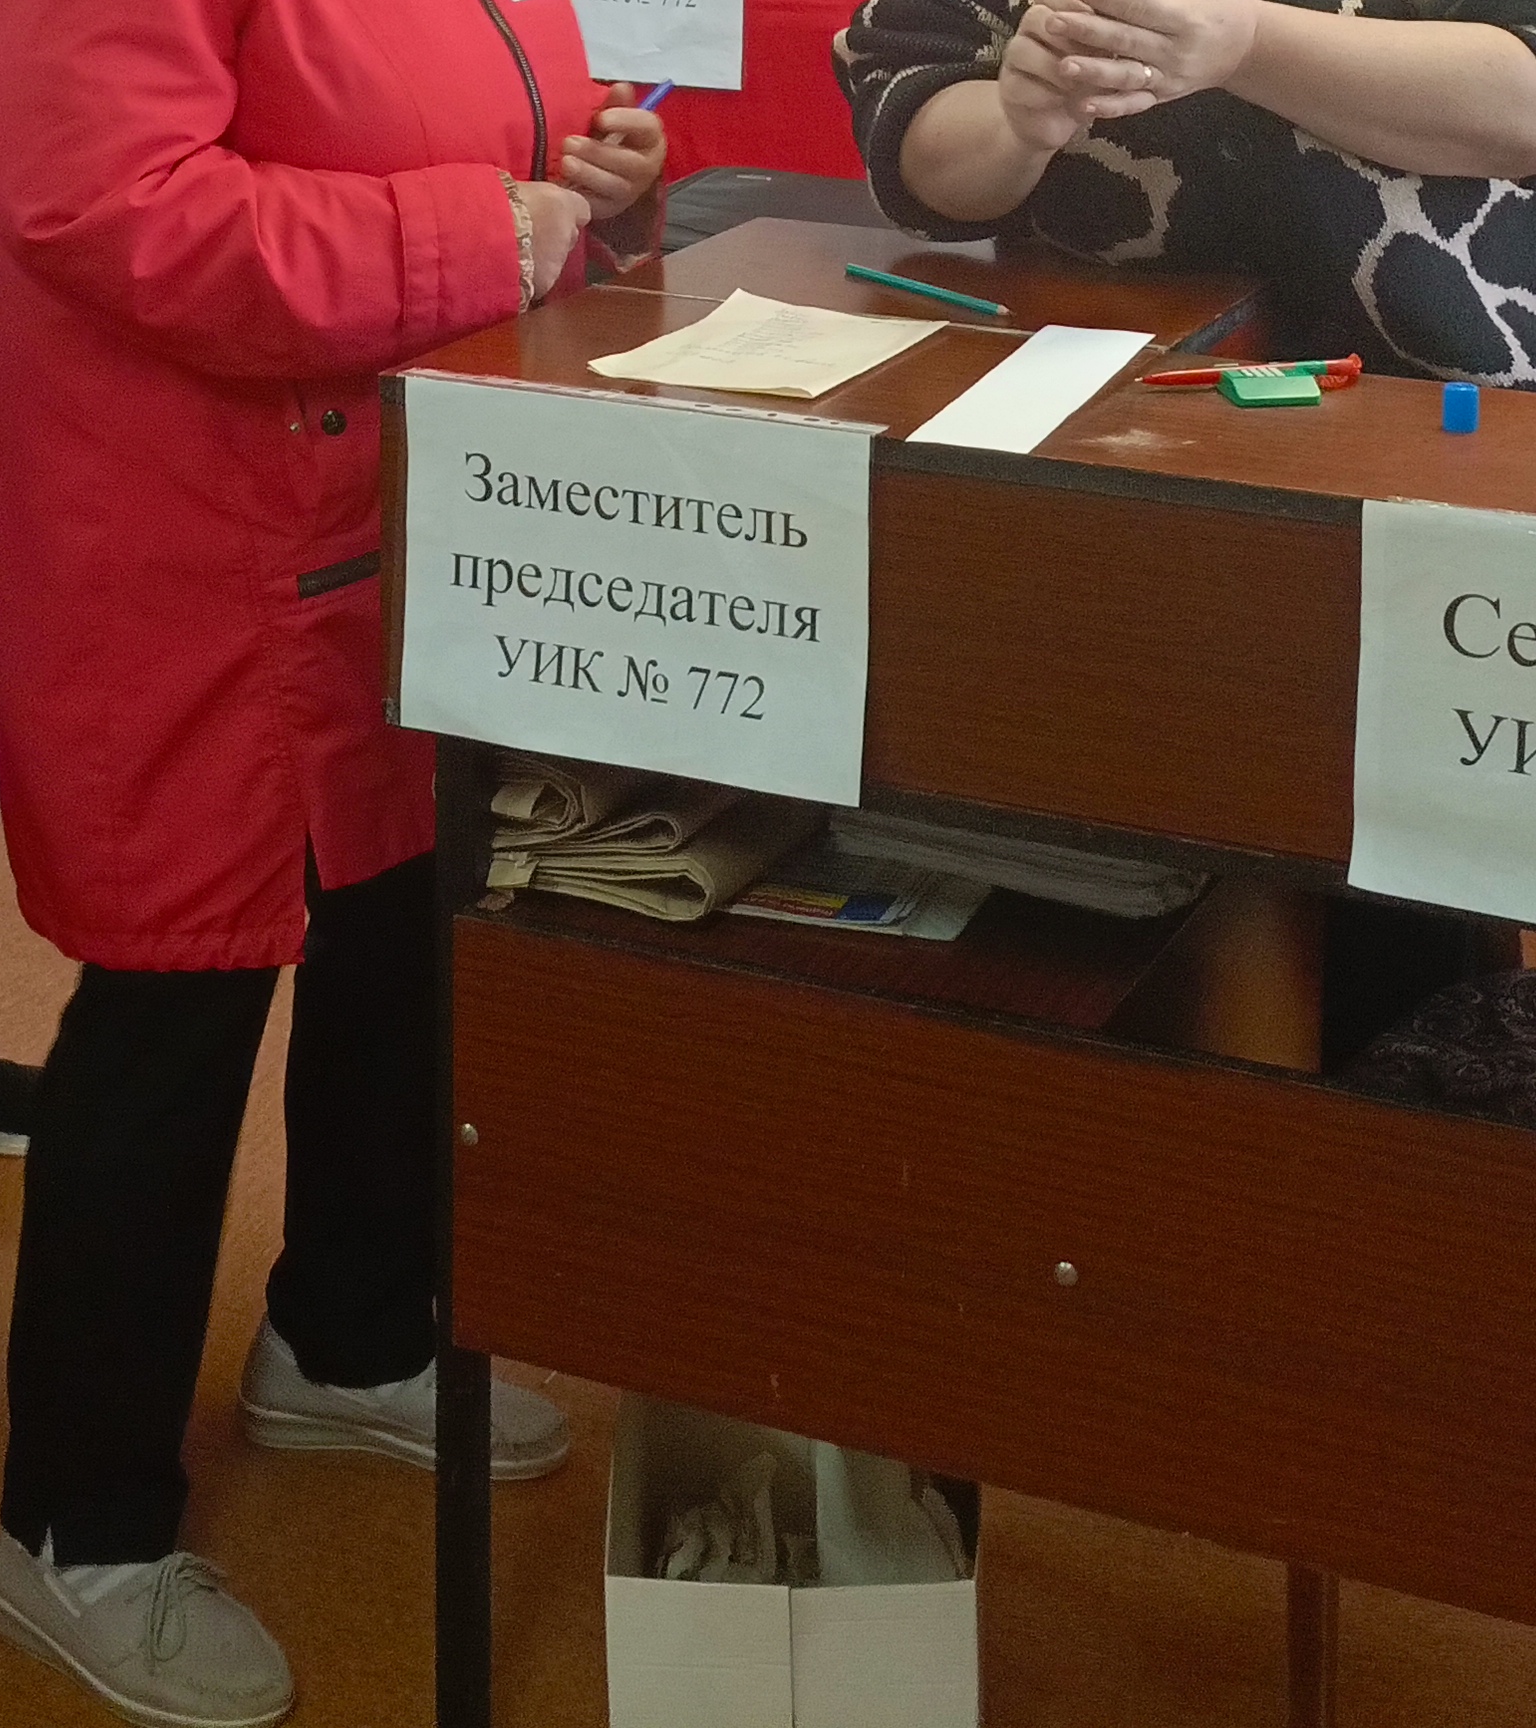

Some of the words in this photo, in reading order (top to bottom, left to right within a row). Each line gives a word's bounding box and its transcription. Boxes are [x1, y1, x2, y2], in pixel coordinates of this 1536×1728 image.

[463, 451, 809, 549] Заместитель
[450, 551, 822, 644] председателя
[495, 633, 605, 695] УИК
[616, 653, 670, 704] №
[686, 664, 767, 721] 772
